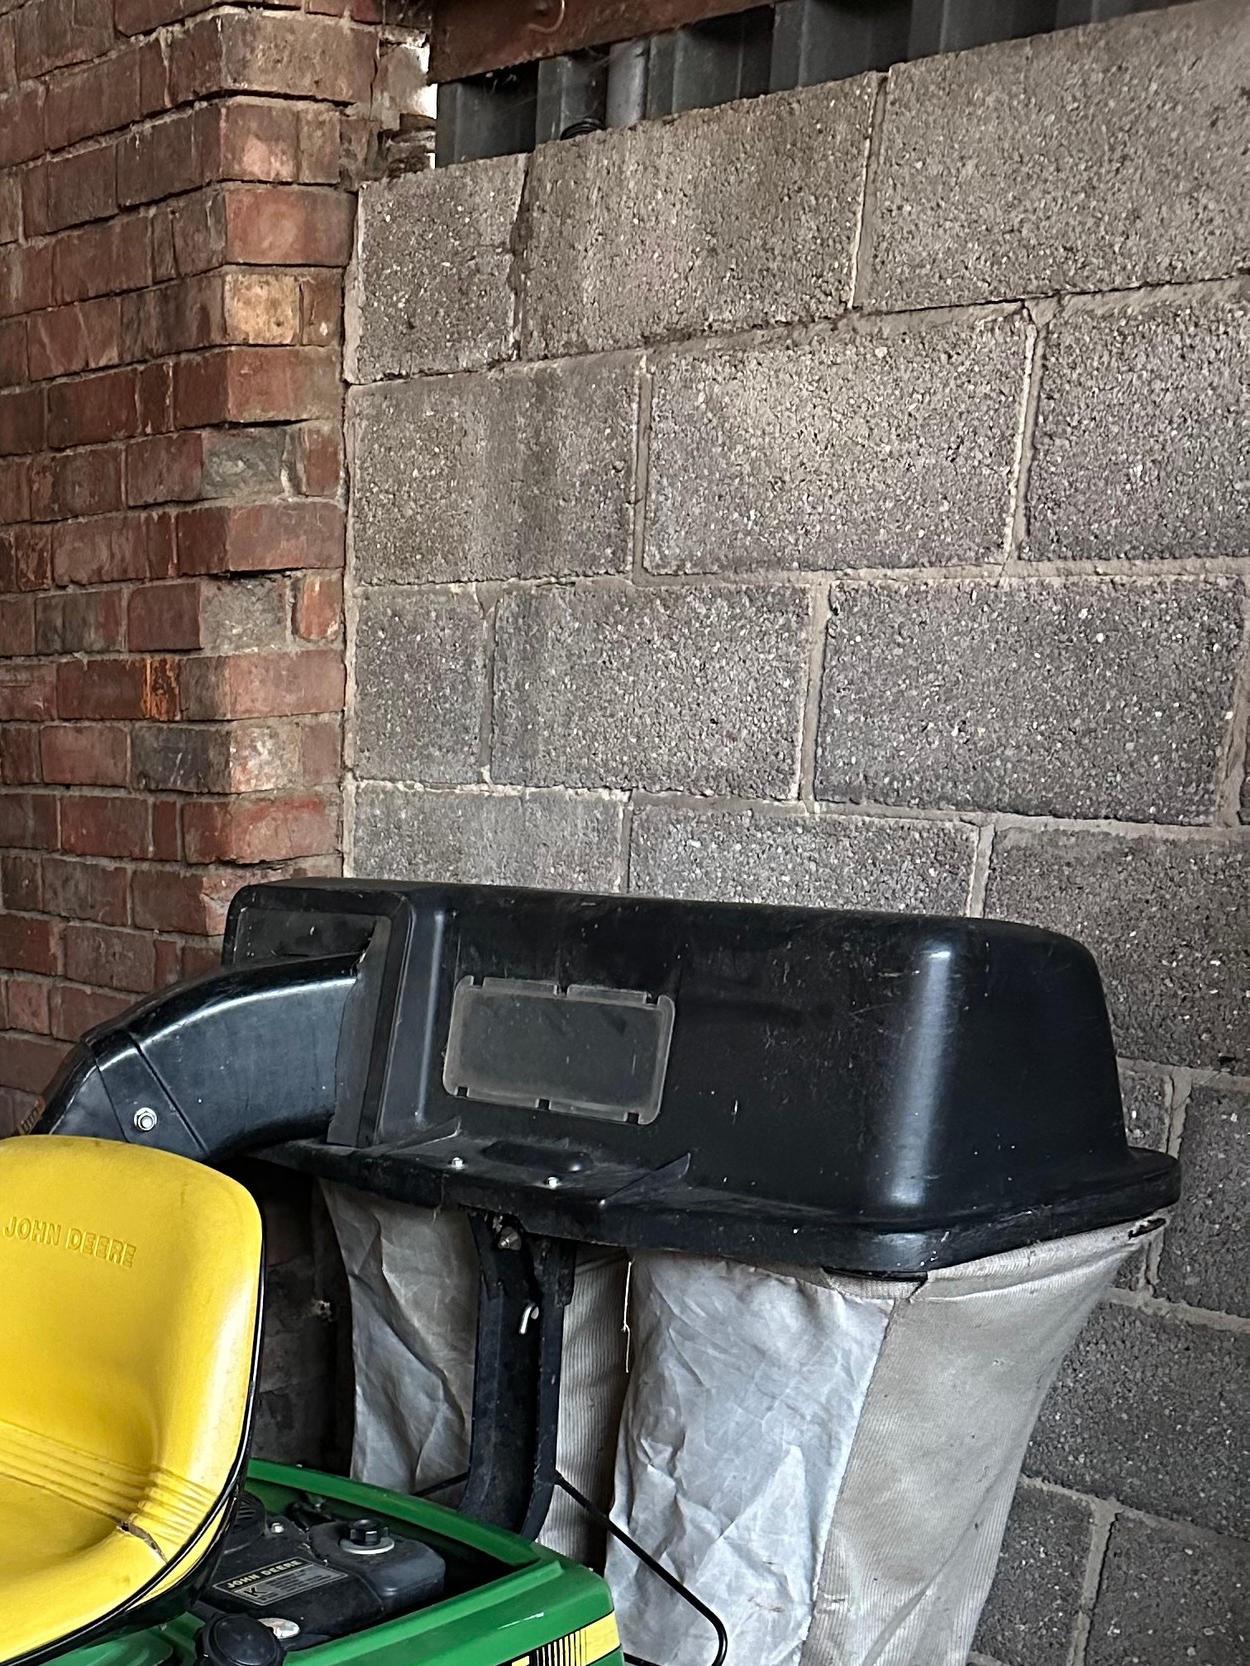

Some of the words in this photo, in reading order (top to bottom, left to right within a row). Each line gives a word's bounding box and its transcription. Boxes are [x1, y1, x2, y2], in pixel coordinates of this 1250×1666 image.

[3, 1216, 62, 1246] JOHN
[65, 1227, 137, 1268] DEERE
[227, 1574, 261, 1589] JOHN
[261, 1560, 303, 1576] DEERE
